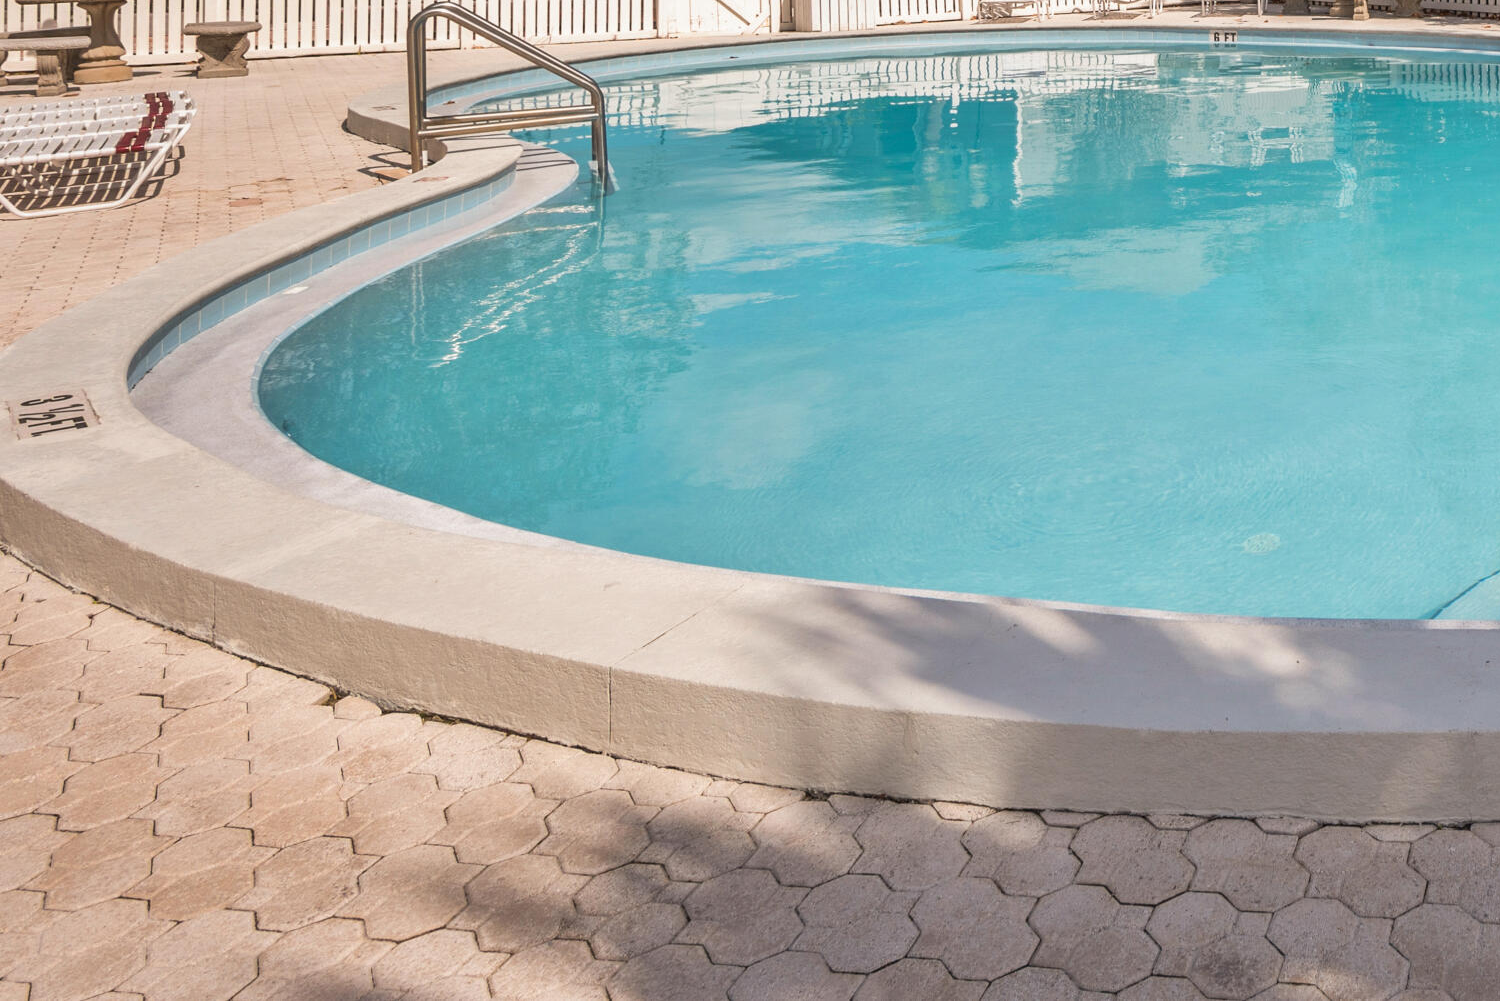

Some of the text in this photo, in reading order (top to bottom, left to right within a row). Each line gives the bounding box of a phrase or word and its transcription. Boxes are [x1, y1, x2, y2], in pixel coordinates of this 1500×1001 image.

[1214, 32, 1236, 42] 6 FT
[20, 395, 73, 406] 3
